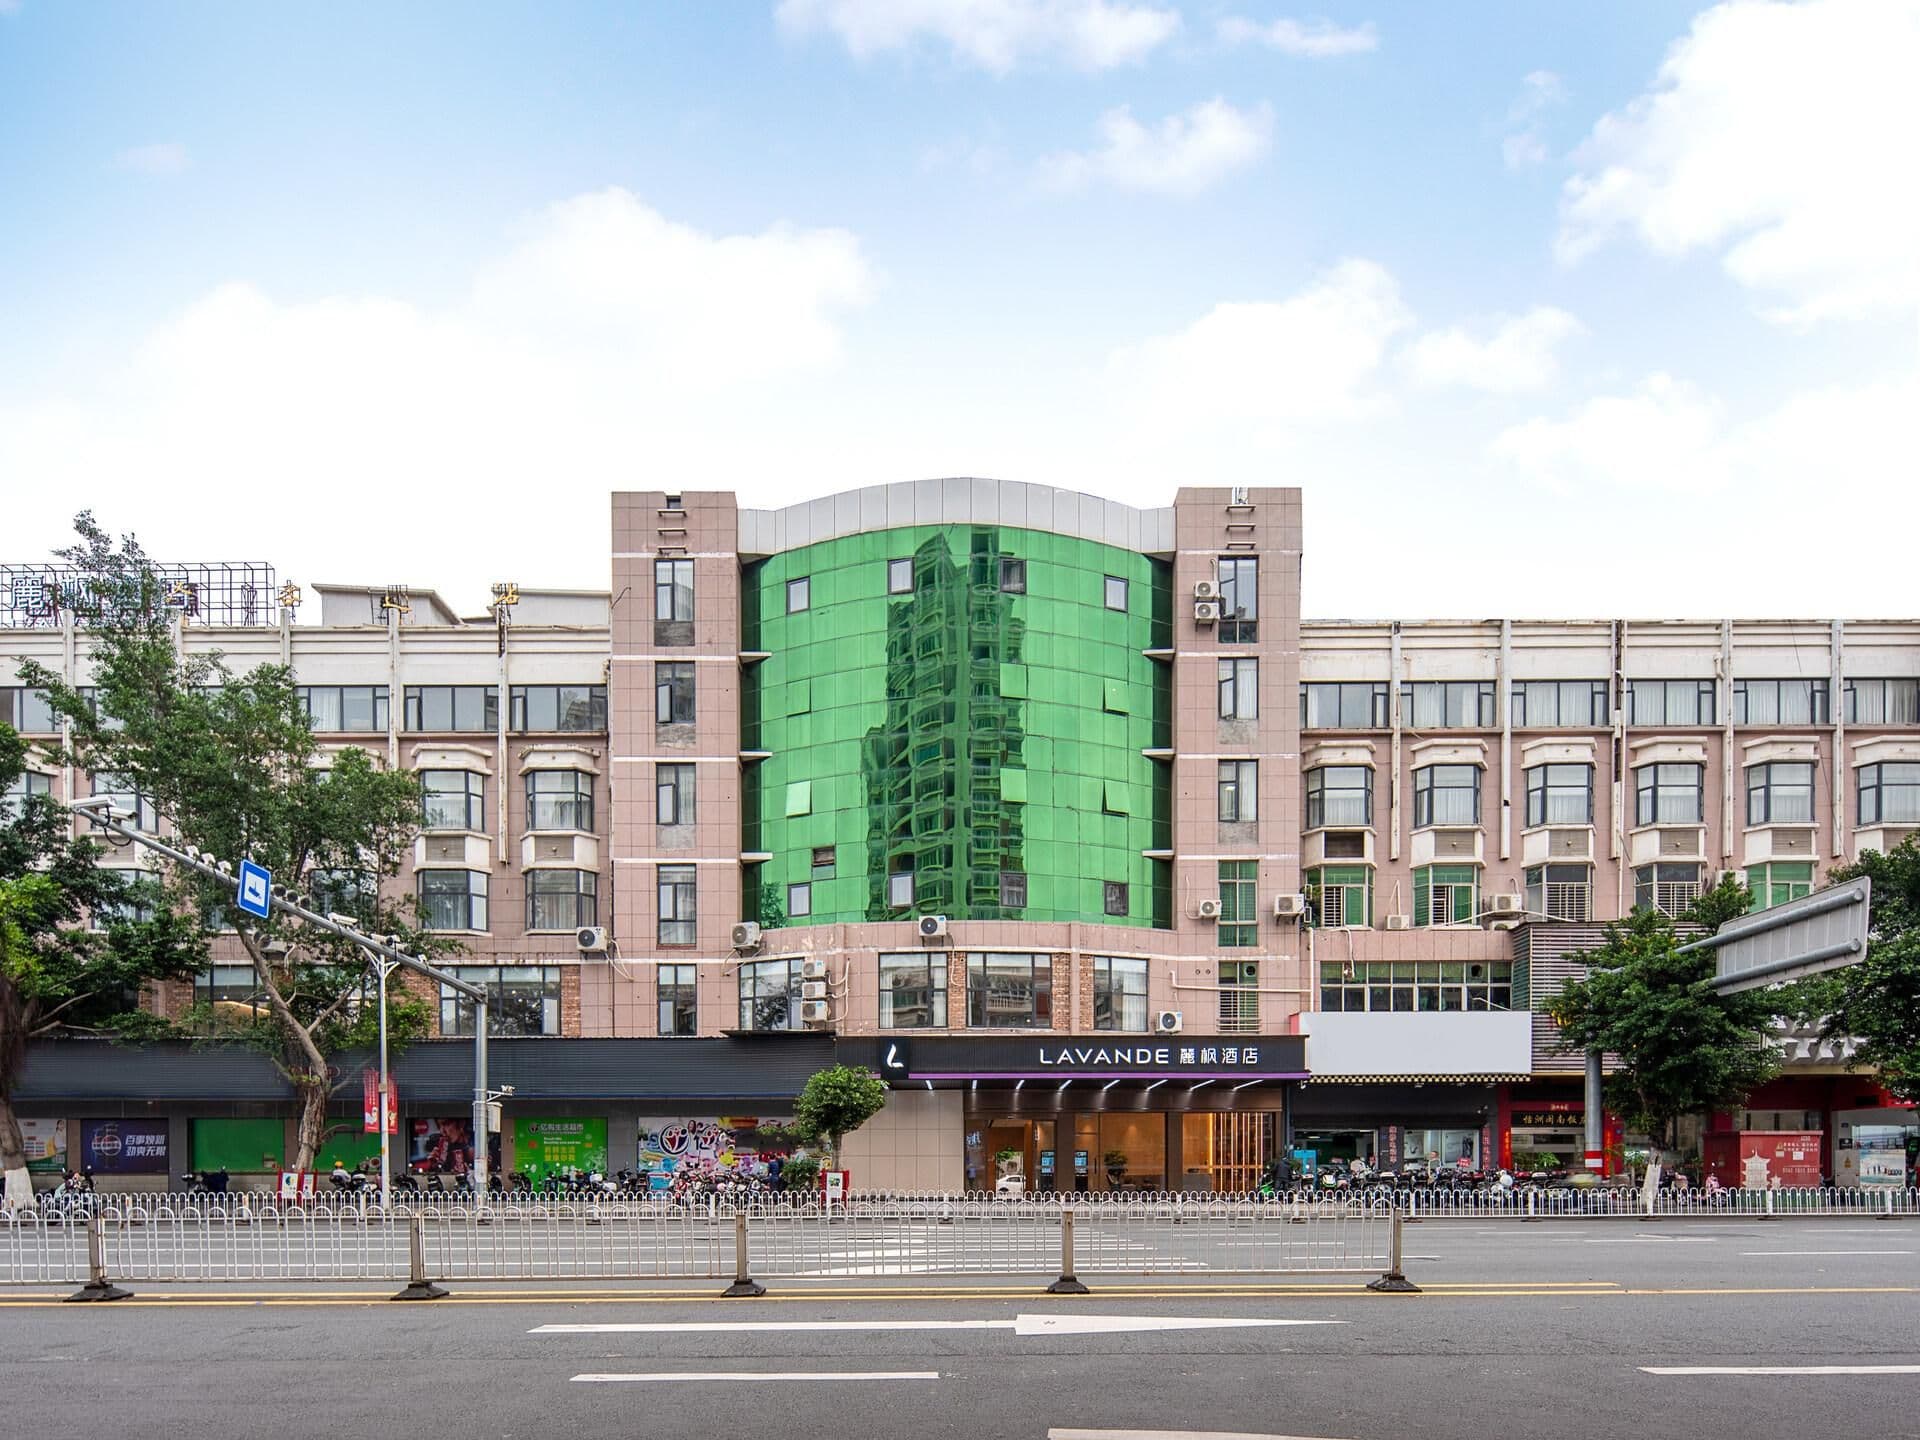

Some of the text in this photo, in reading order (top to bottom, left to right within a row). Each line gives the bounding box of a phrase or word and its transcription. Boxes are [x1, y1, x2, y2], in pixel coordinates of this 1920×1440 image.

[1039, 1047, 1259, 1065] LAVANDE 麗枫酒店
